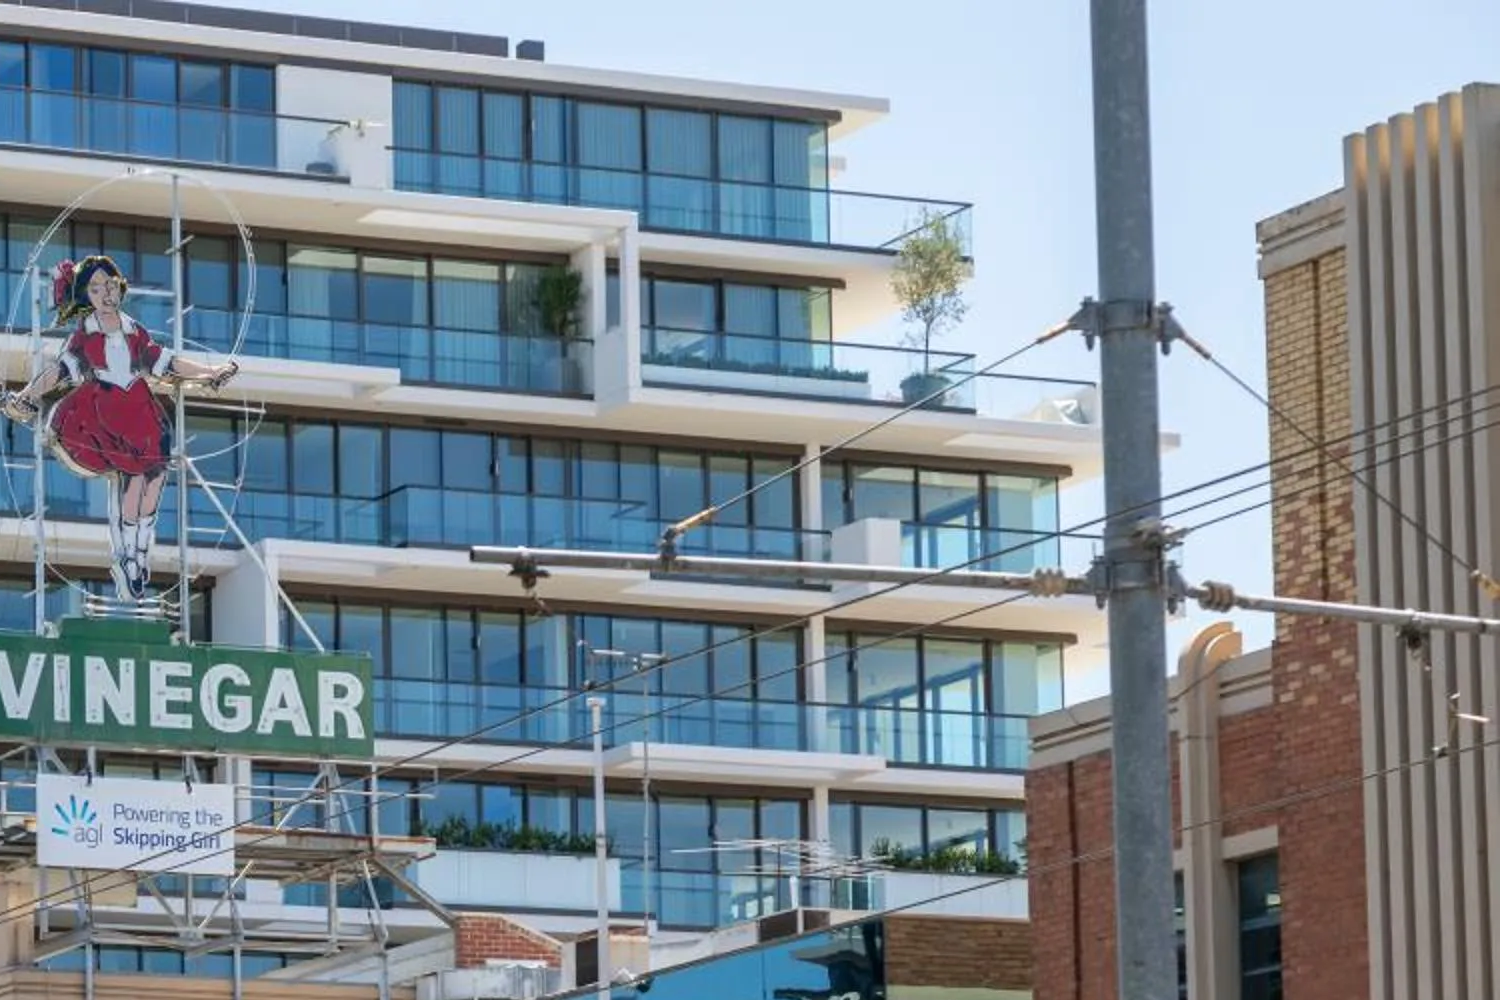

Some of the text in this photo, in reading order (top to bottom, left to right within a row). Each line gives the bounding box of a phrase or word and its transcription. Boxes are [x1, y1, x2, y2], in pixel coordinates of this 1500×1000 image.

[113, 803, 223, 829] Powering the
[73, 823, 103, 849] agl
[113, 827, 221, 852] Skipping Girl
